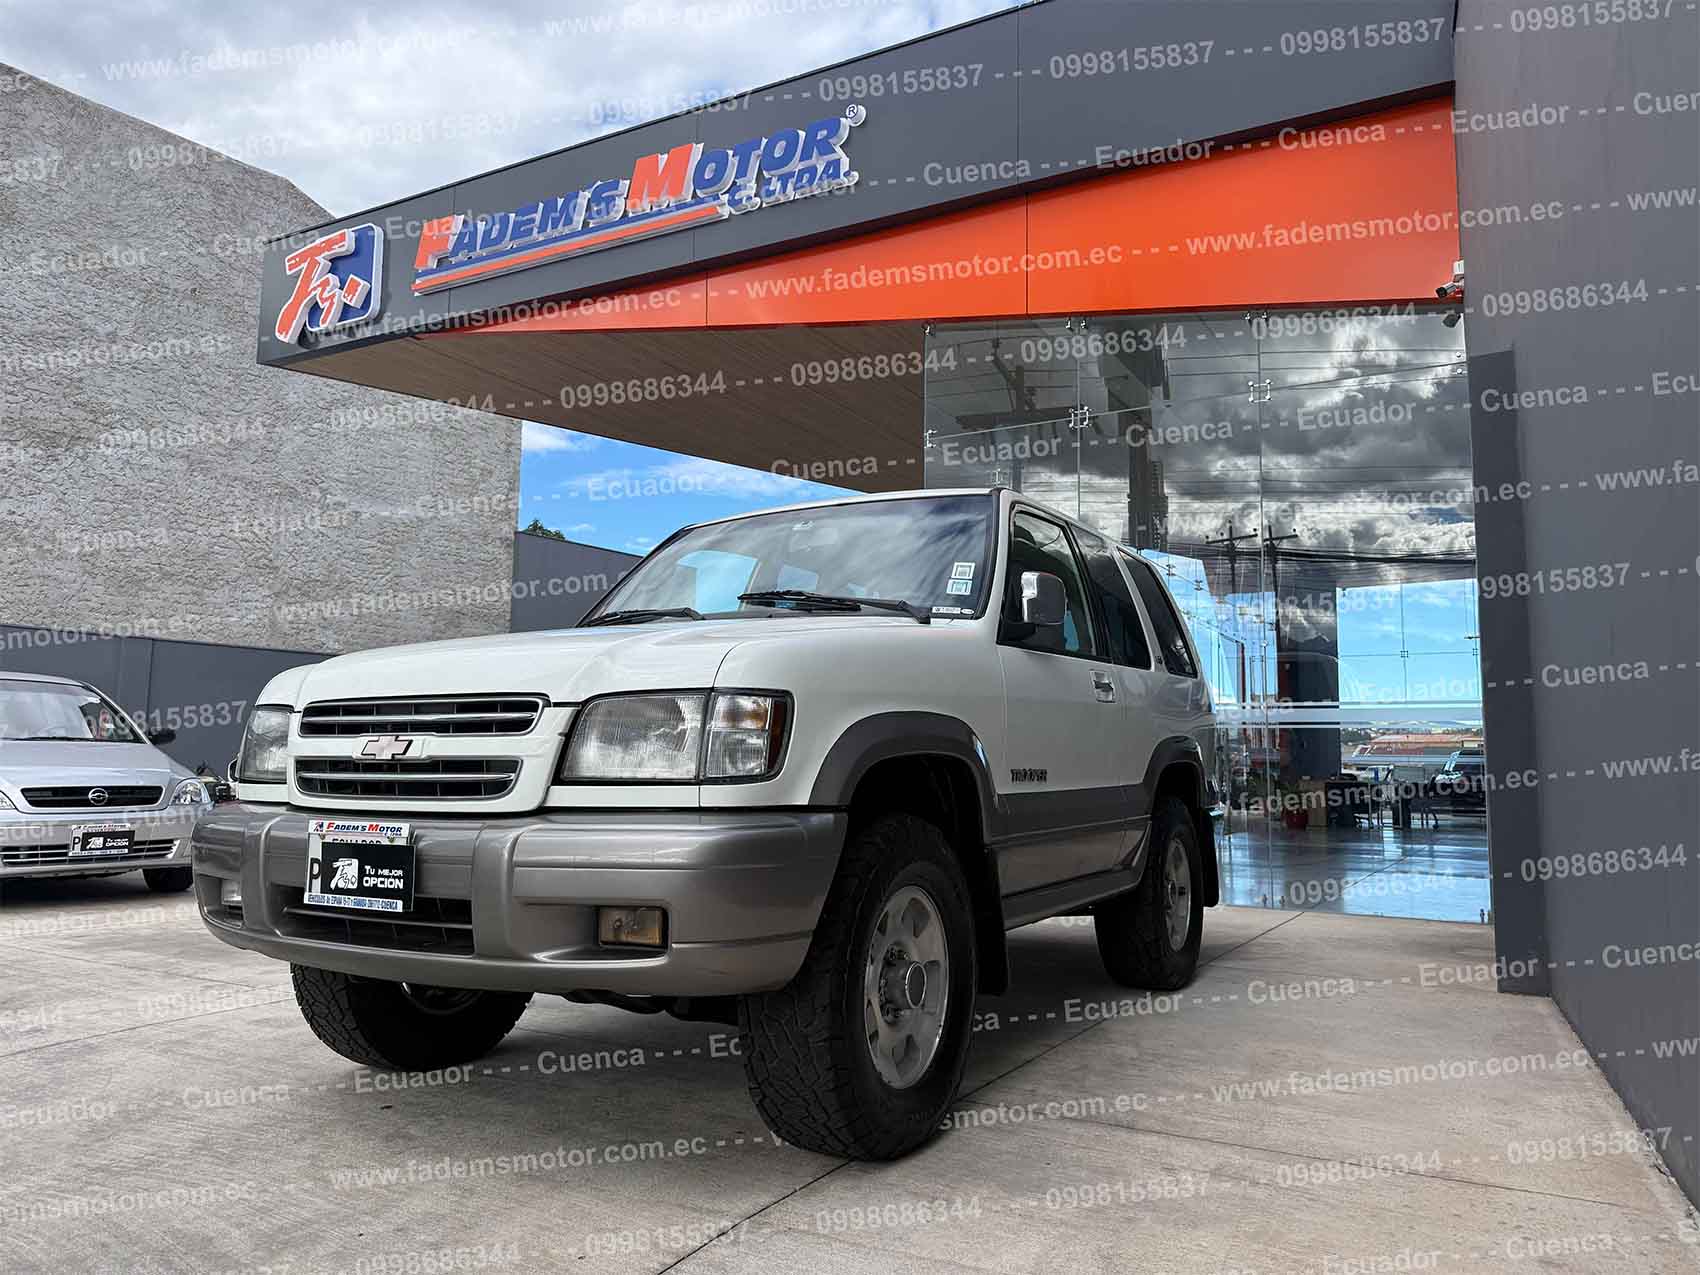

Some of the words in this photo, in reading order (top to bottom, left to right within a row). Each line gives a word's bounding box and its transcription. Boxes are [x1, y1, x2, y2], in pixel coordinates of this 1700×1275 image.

[627, 116, 850, 214] MOTOR
[326, 821, 367, 832] FADEM'S
[367, 823, 403, 833] MOTOR
[310, 857, 321, 892] P
